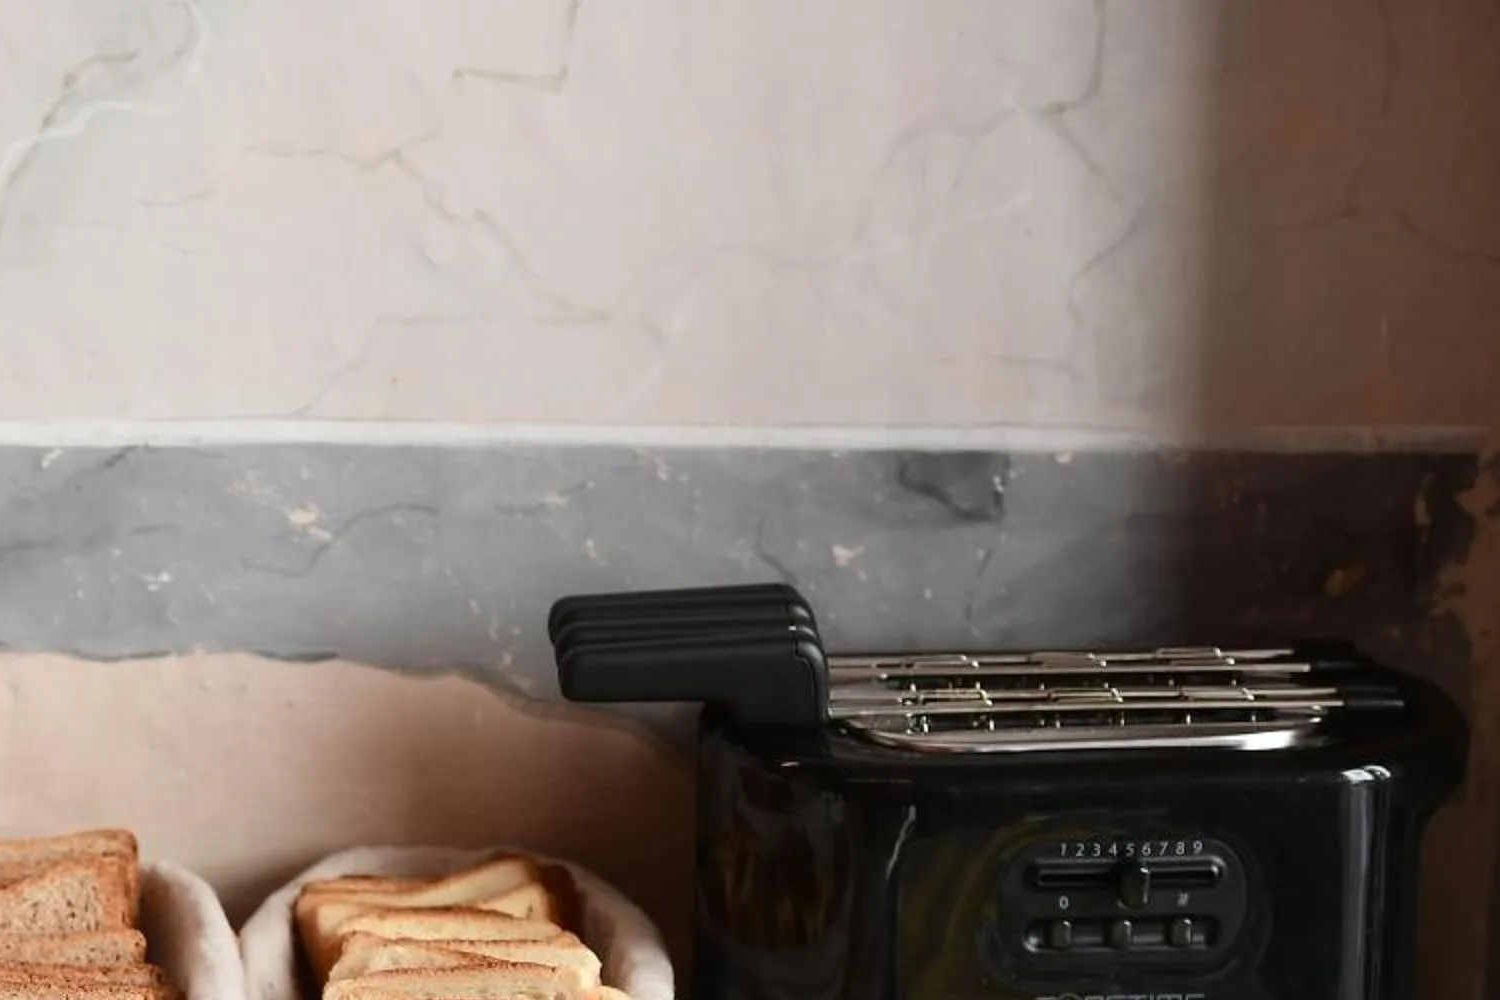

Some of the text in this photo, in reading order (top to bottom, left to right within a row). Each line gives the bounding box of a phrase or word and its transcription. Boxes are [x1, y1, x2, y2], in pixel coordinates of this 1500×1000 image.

[1061, 840, 1202, 857] 1 2 3 4 5 6 7 8 9
